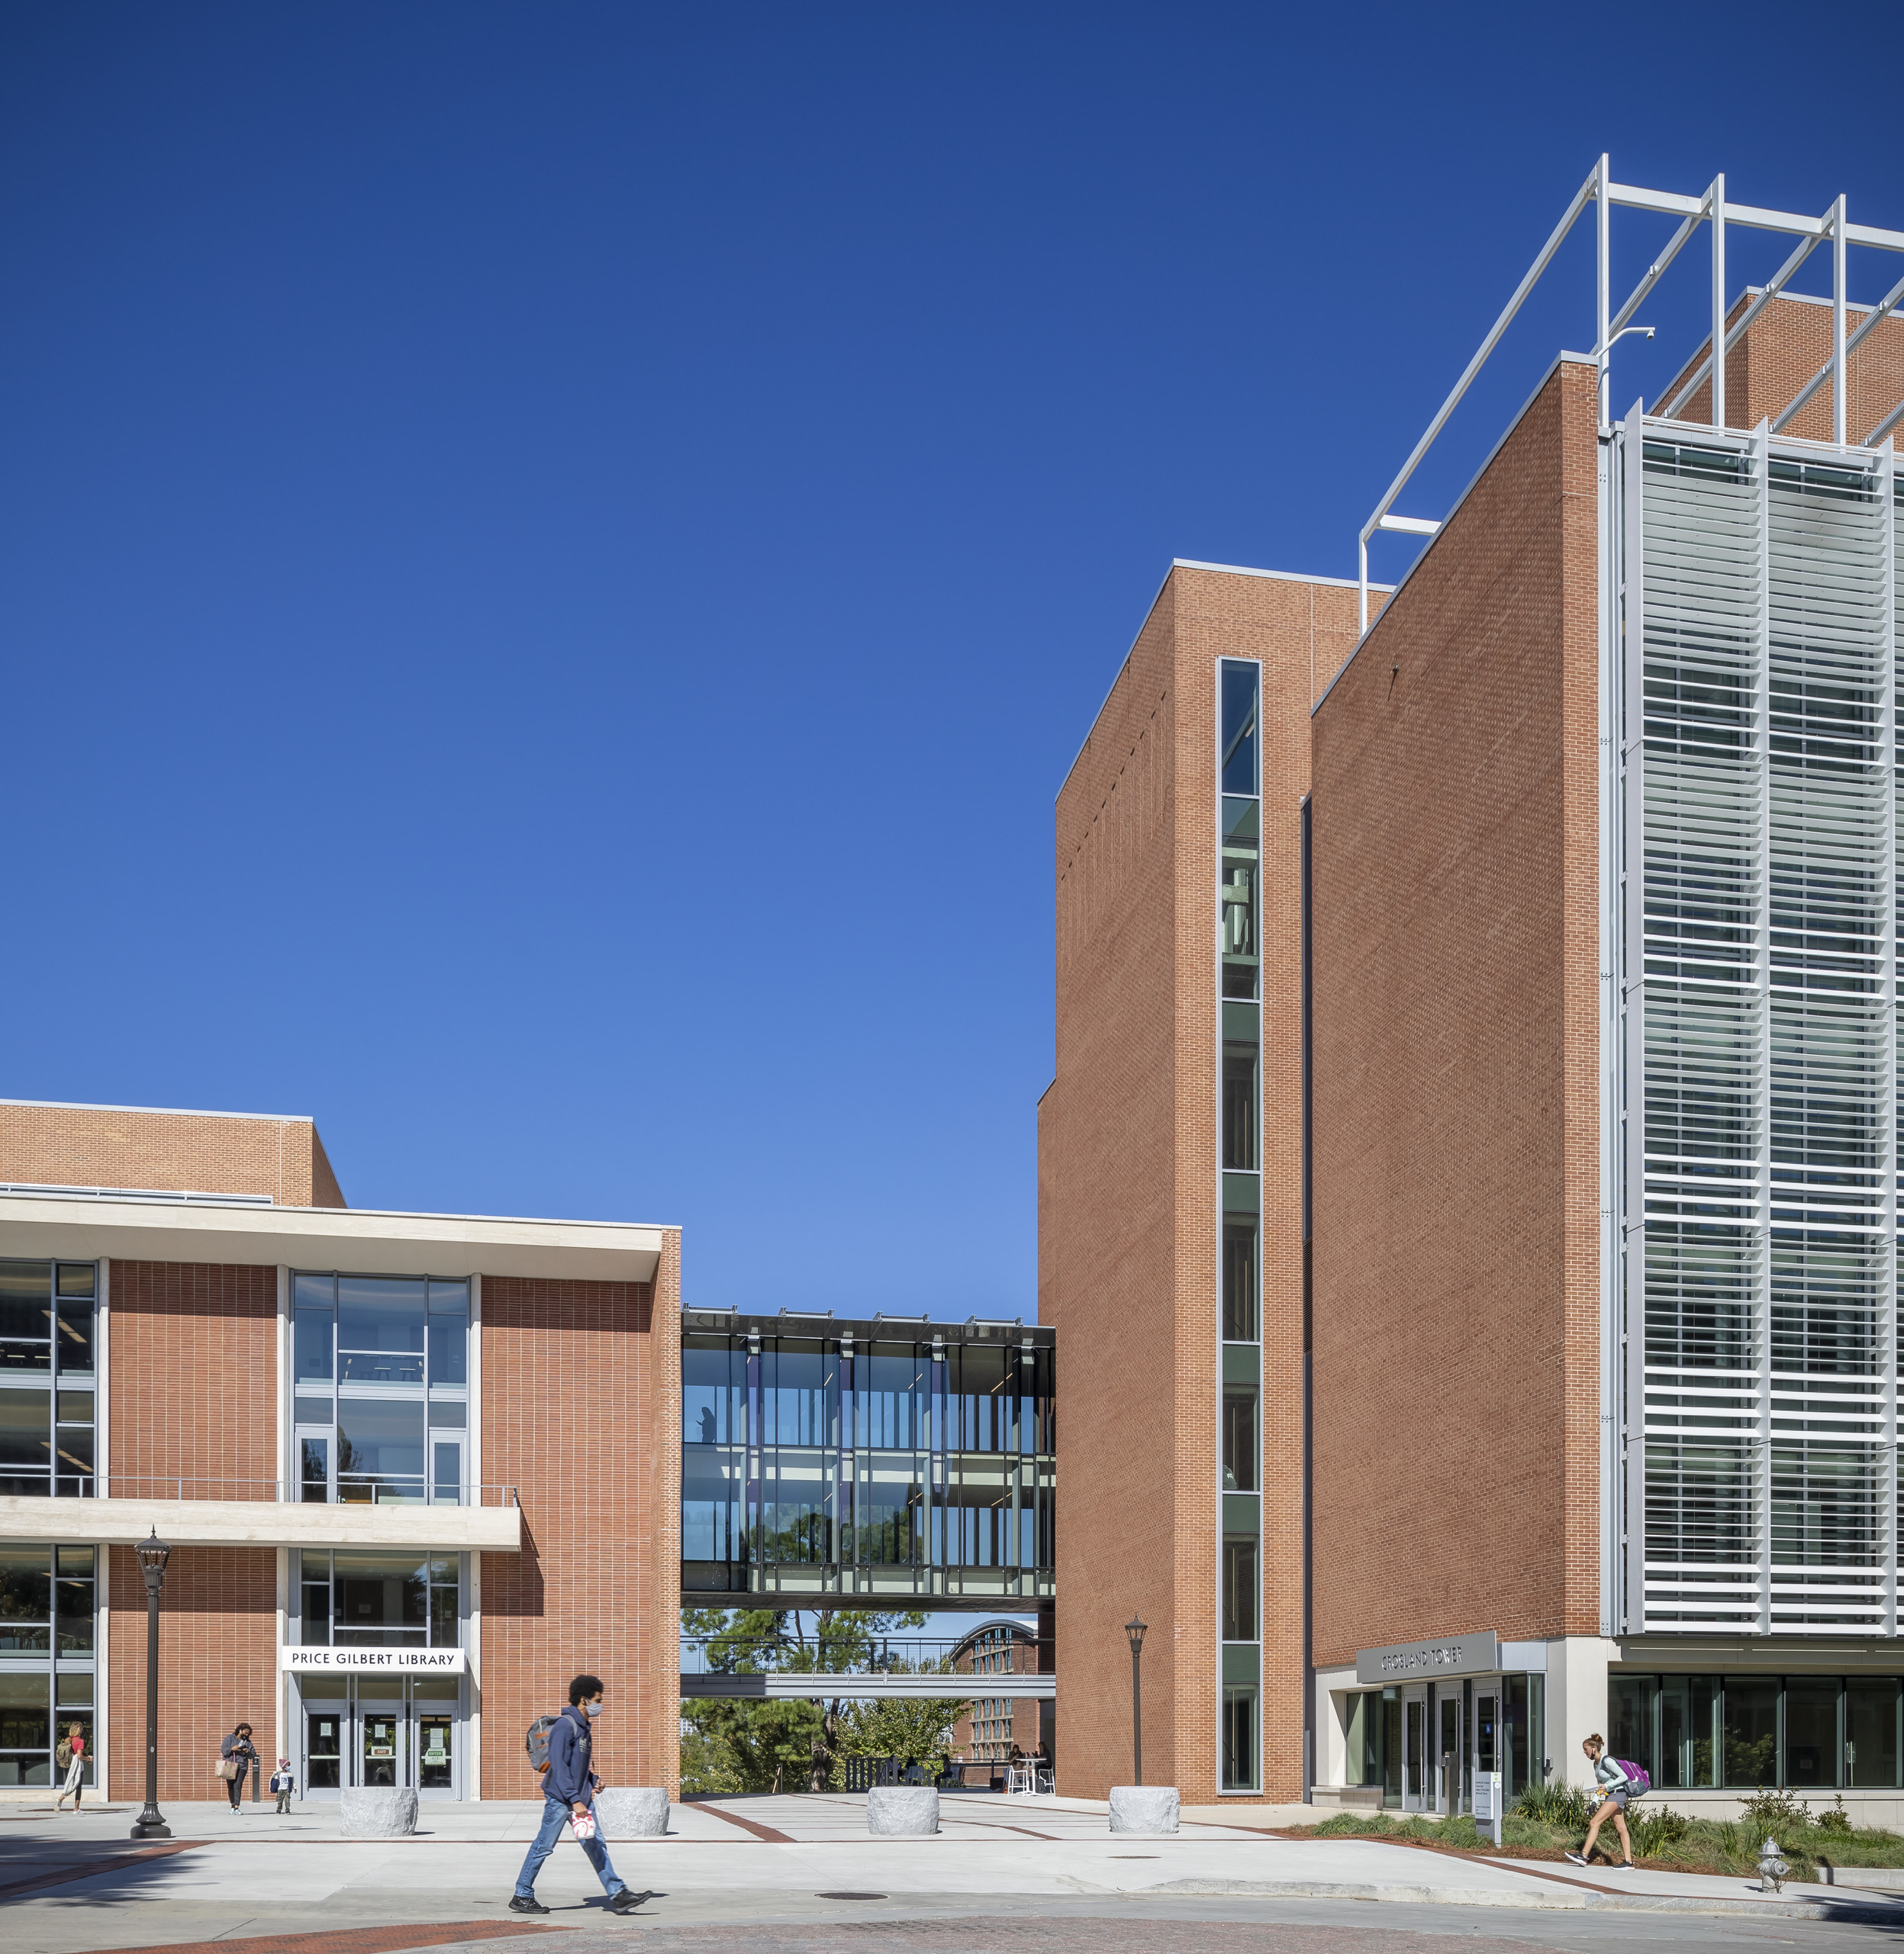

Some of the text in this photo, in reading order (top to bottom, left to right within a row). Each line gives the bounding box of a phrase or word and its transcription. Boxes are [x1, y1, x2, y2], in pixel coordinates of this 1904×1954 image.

[292, 1653, 455, 1665] PRICE GILBERT LIBRARY
[1381, 1646, 1463, 1671] CROSLAND TOWER
